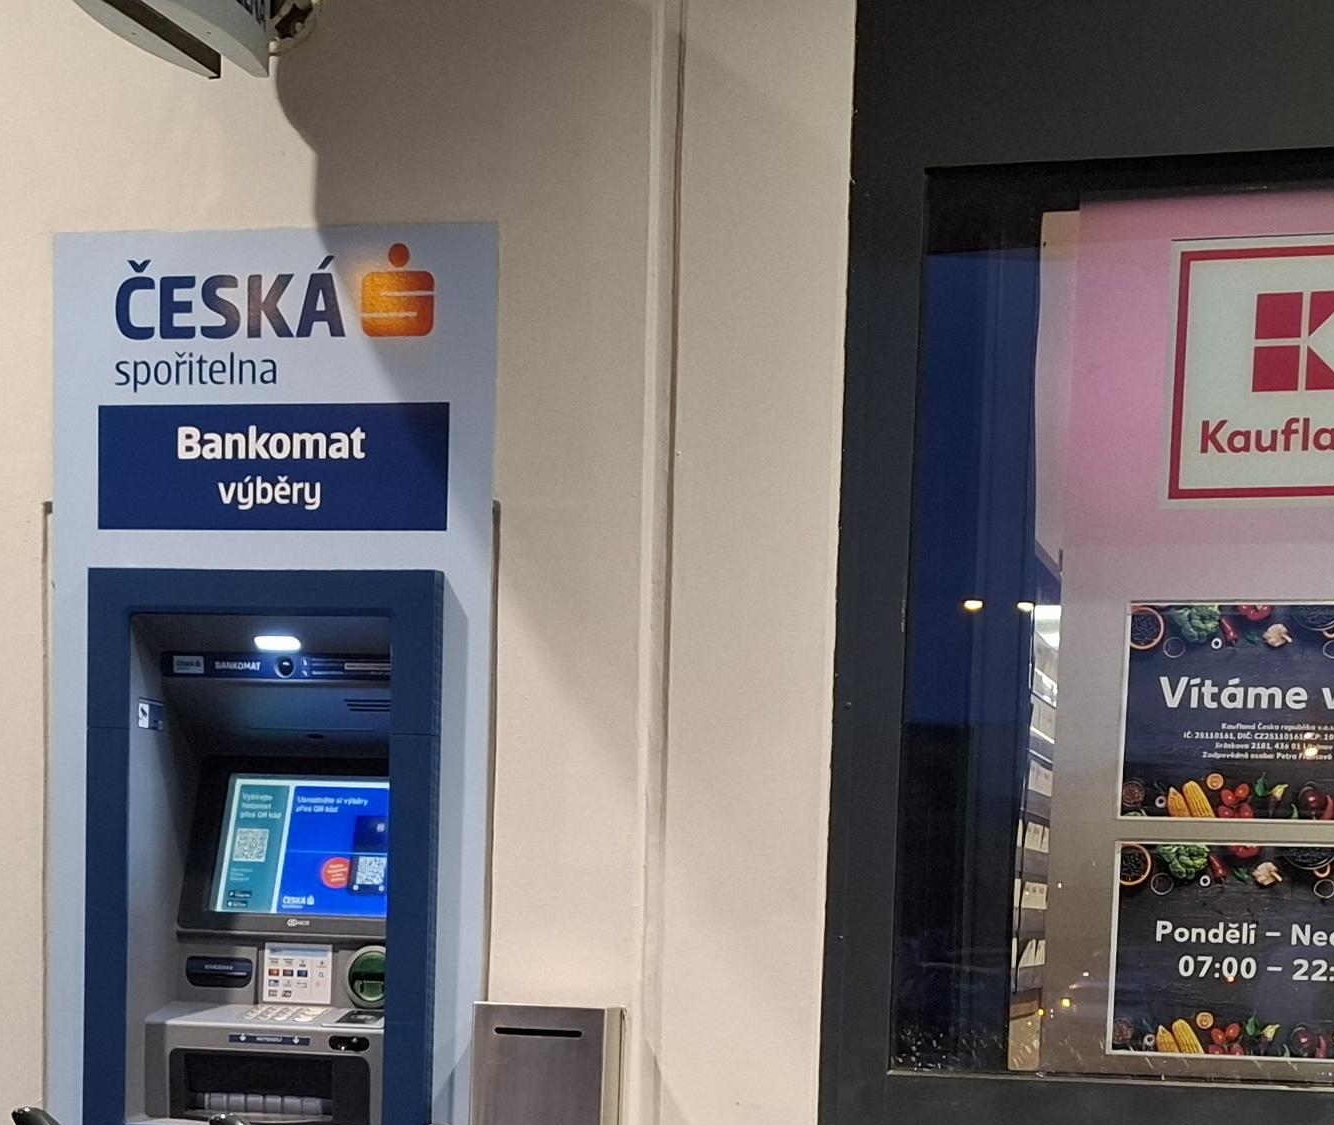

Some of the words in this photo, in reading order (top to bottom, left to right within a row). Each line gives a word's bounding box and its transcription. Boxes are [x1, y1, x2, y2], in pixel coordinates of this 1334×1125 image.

[115, 256, 346, 340] ČESKÁ
[115, 352, 278, 392] spořitelna
[177, 425, 365, 461] Bankomat
[219, 477, 322, 510] výběry
[215, 661, 261, 671] BANKOMAT
[1160, 676, 1307, 710] Vítáme
[1221, 722, 1256, 731] Kaufland
[1155, 920, 1258, 945] Pondělí
[1178, 956, 1257, 979] 07:00
